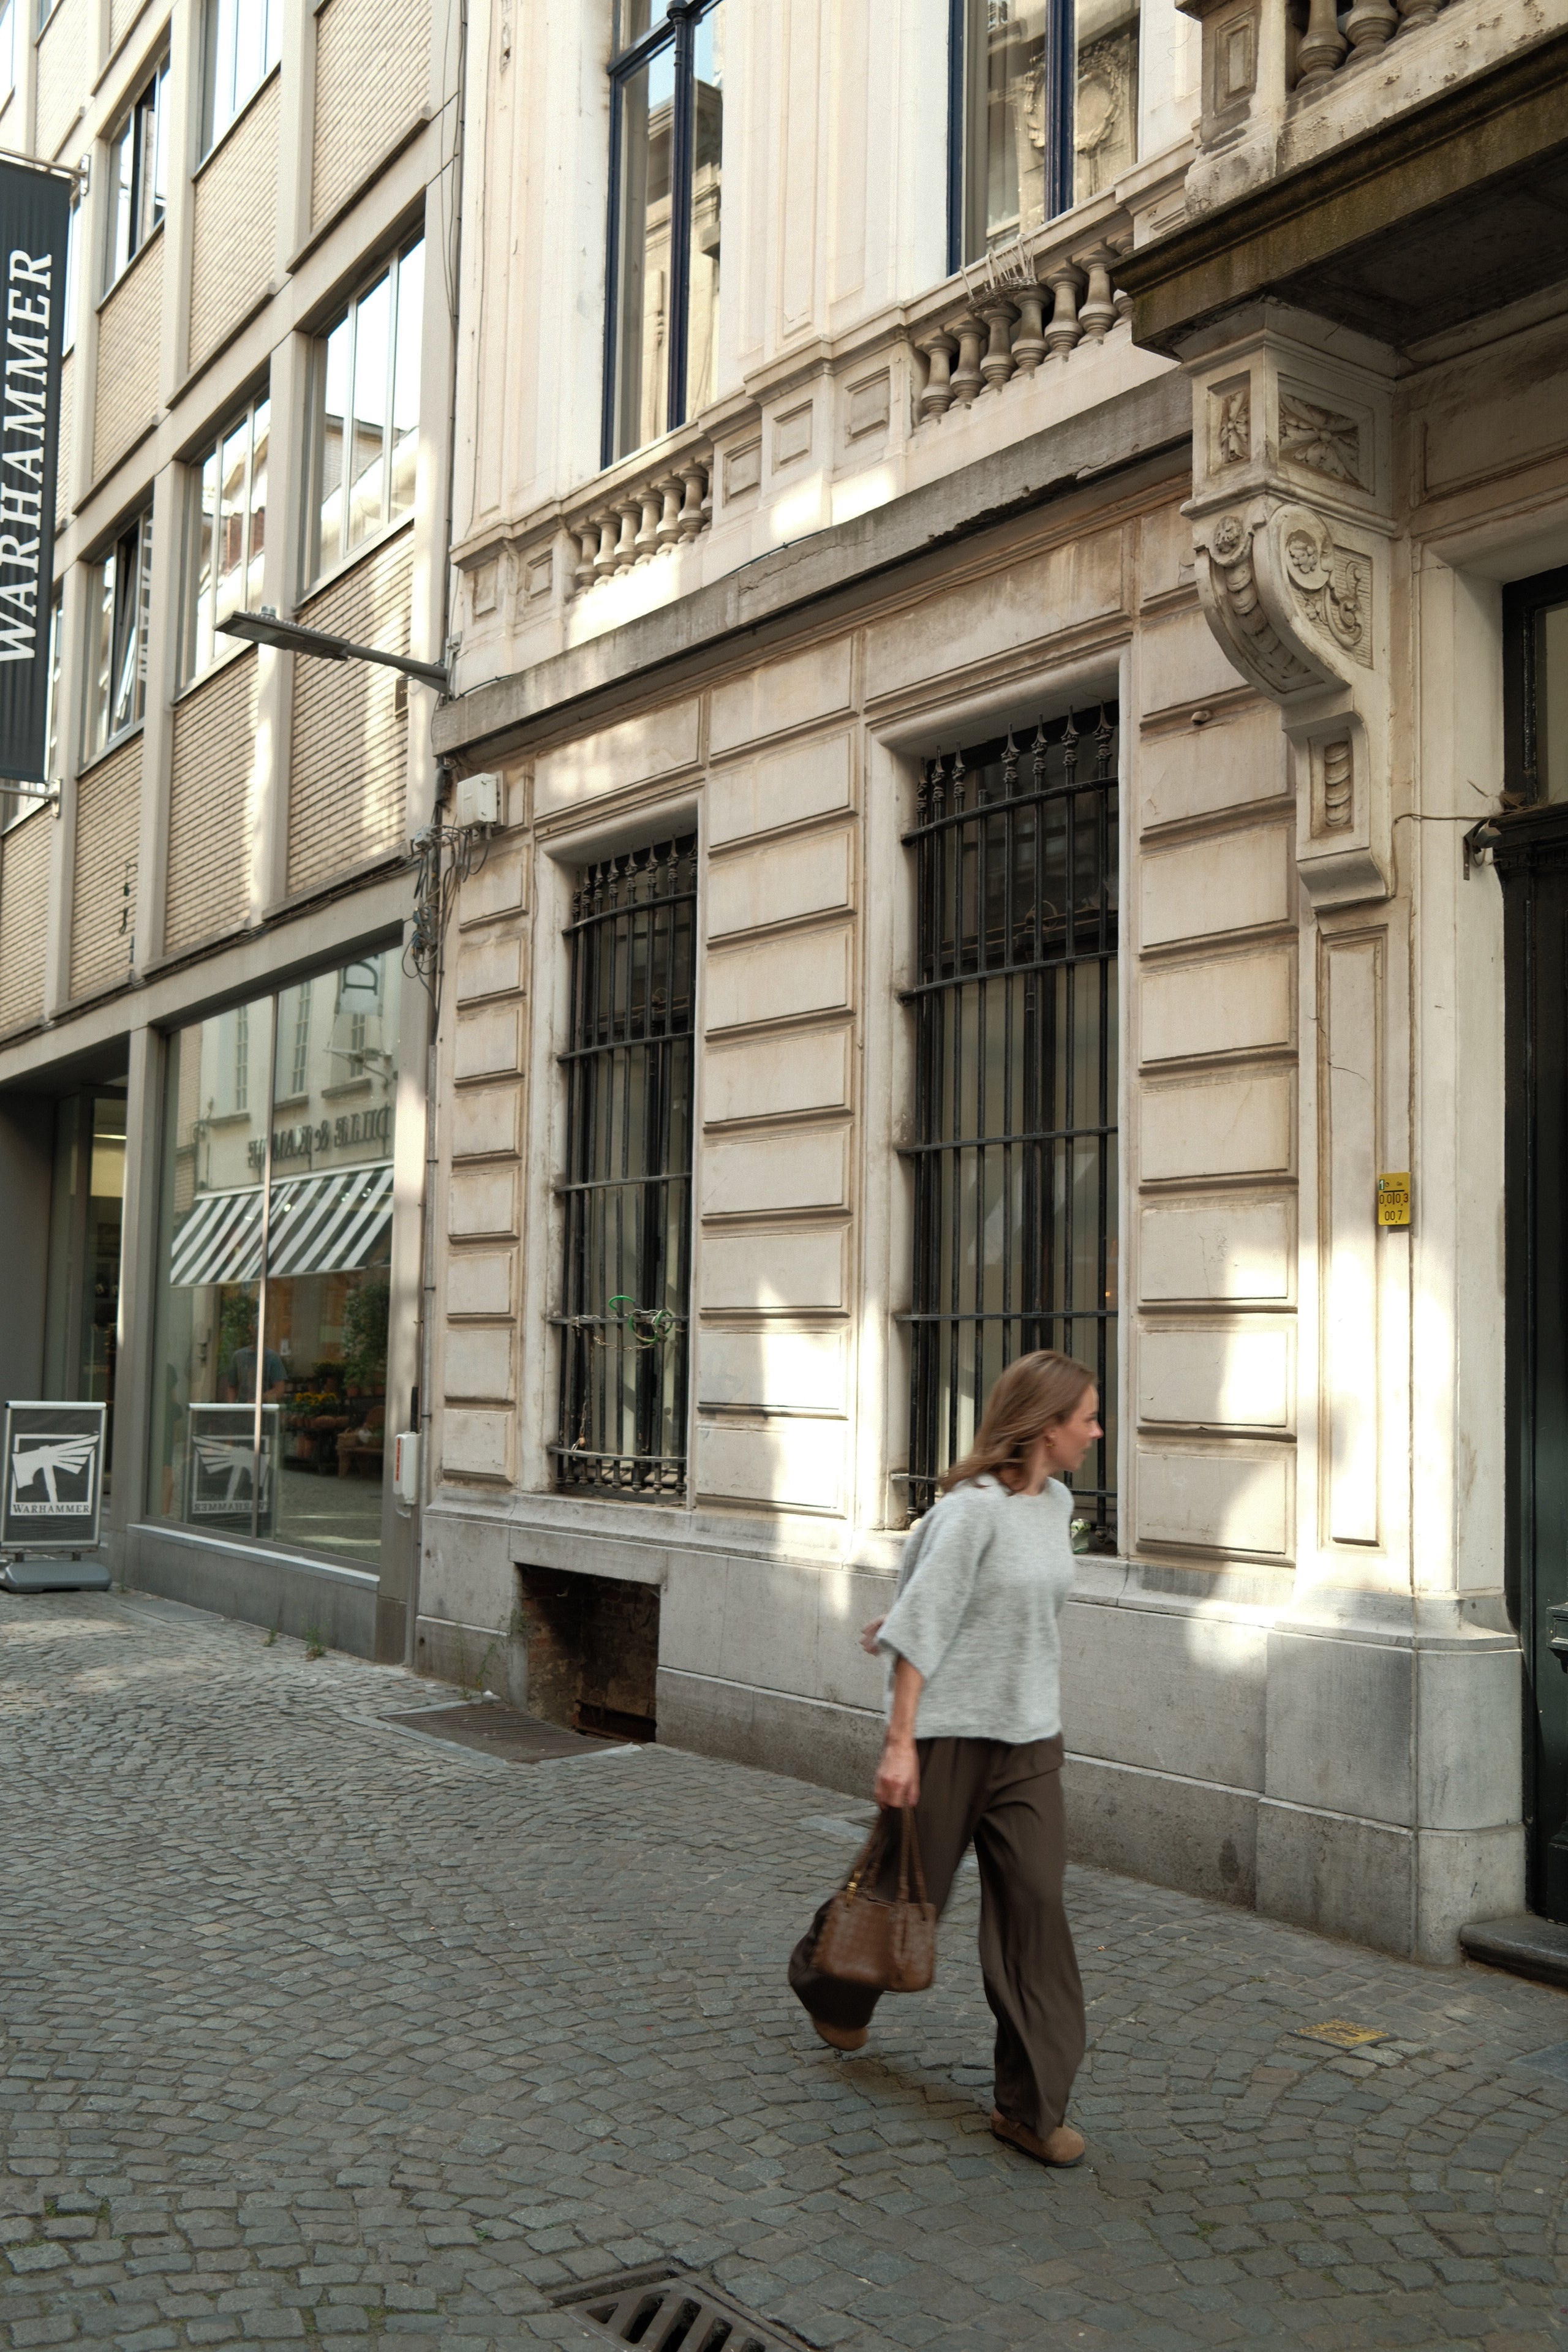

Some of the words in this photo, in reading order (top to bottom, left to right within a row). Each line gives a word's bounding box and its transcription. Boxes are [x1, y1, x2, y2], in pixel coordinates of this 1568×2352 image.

[0, 249, 52, 662] WARHAMMER
[1379, 1180, 1384, 1190] 1
[12, 1504, 89, 1513] WARHAMMER
